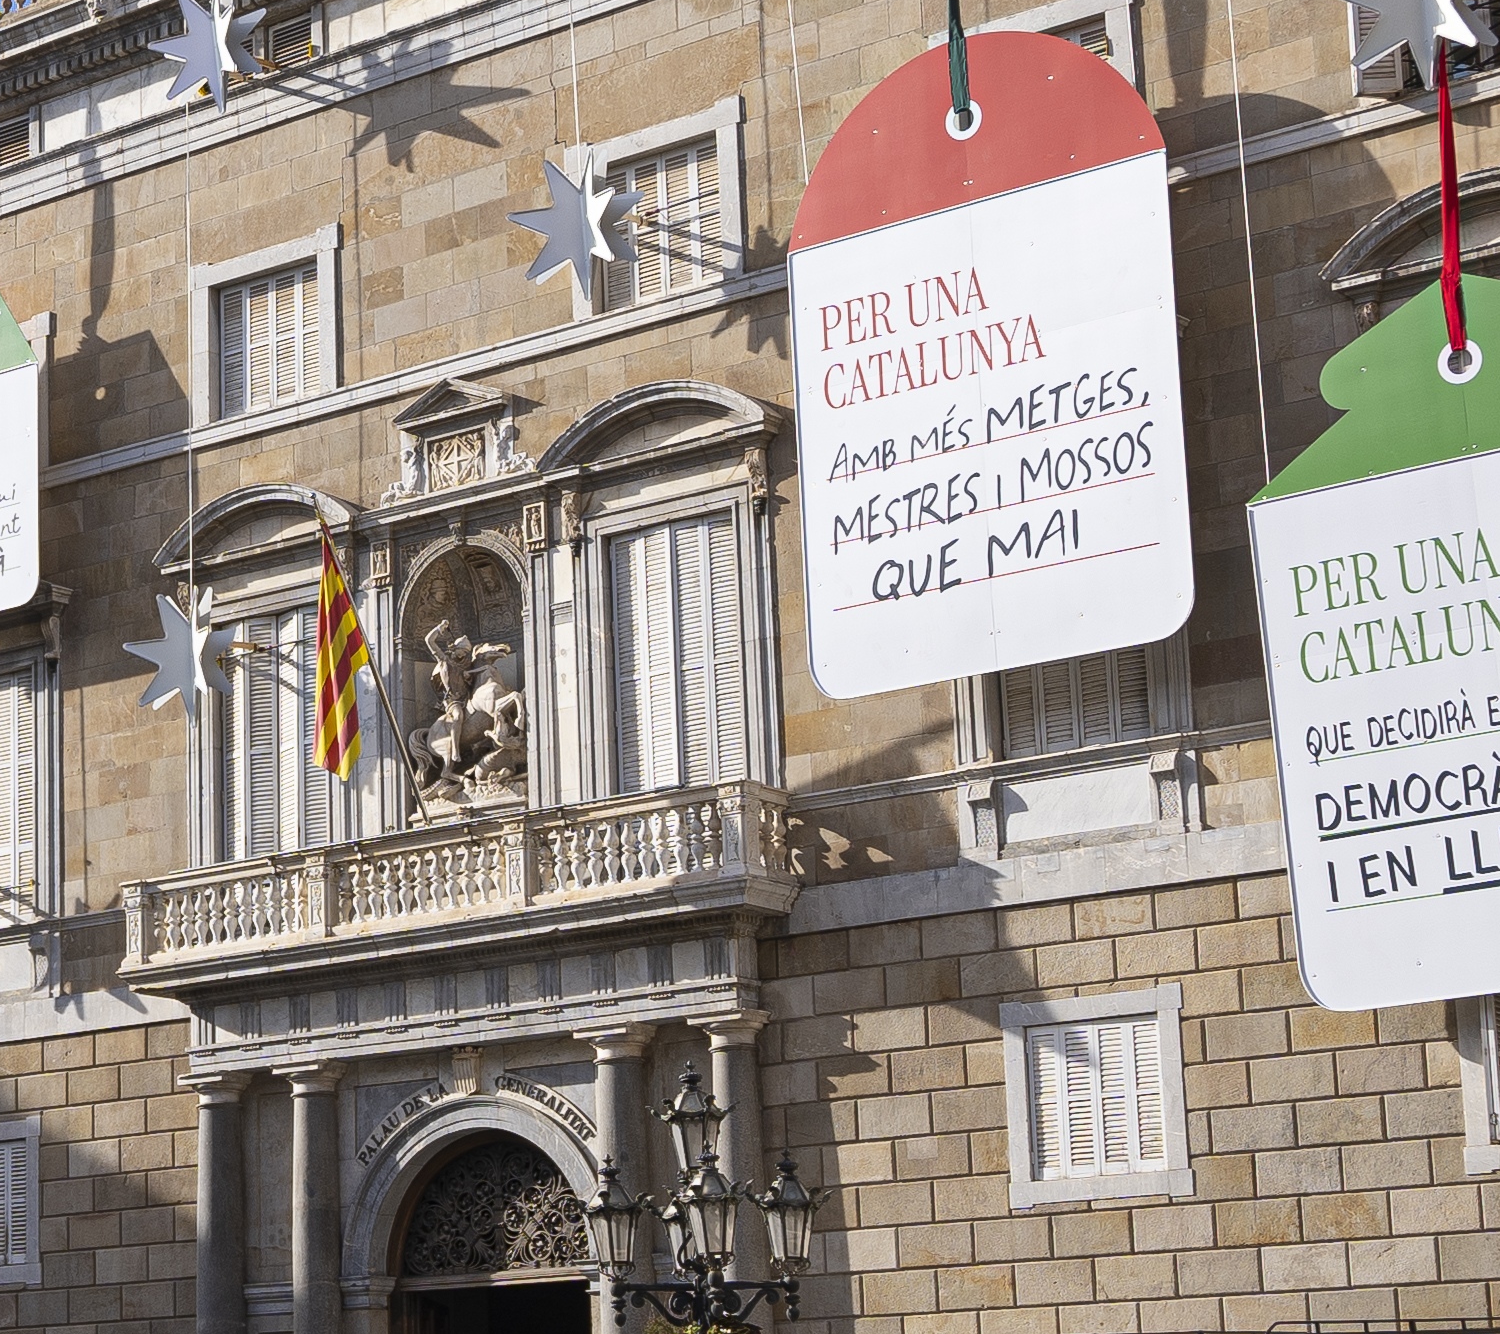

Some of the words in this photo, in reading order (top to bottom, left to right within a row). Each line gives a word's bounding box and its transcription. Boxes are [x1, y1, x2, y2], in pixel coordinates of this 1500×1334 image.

[819, 291, 897, 352] PER
[904, 267, 990, 327] UNA
[823, 314, 1047, 410] CATALUNYA
[829, 442, 897, 484] AMB
[910, 404, 974, 463] MÉS
[986, 367, 1151, 444] METGES,
[833, 472, 980, 555] MESTRES
[995, 474, 1002, 511] I
[1021, 421, 1154, 503] MOSSOS
[872, 539, 962, 601] QUE
[987, 508, 1080, 578] MAI
[1288, 551, 1388, 618] PER
[1306, 720, 1355, 767] QUE
[1368, 688, 1475, 748] DECIDIRÀ
[1326, 860, 1339, 903] I
[1361, 845, 1419, 899] EN
